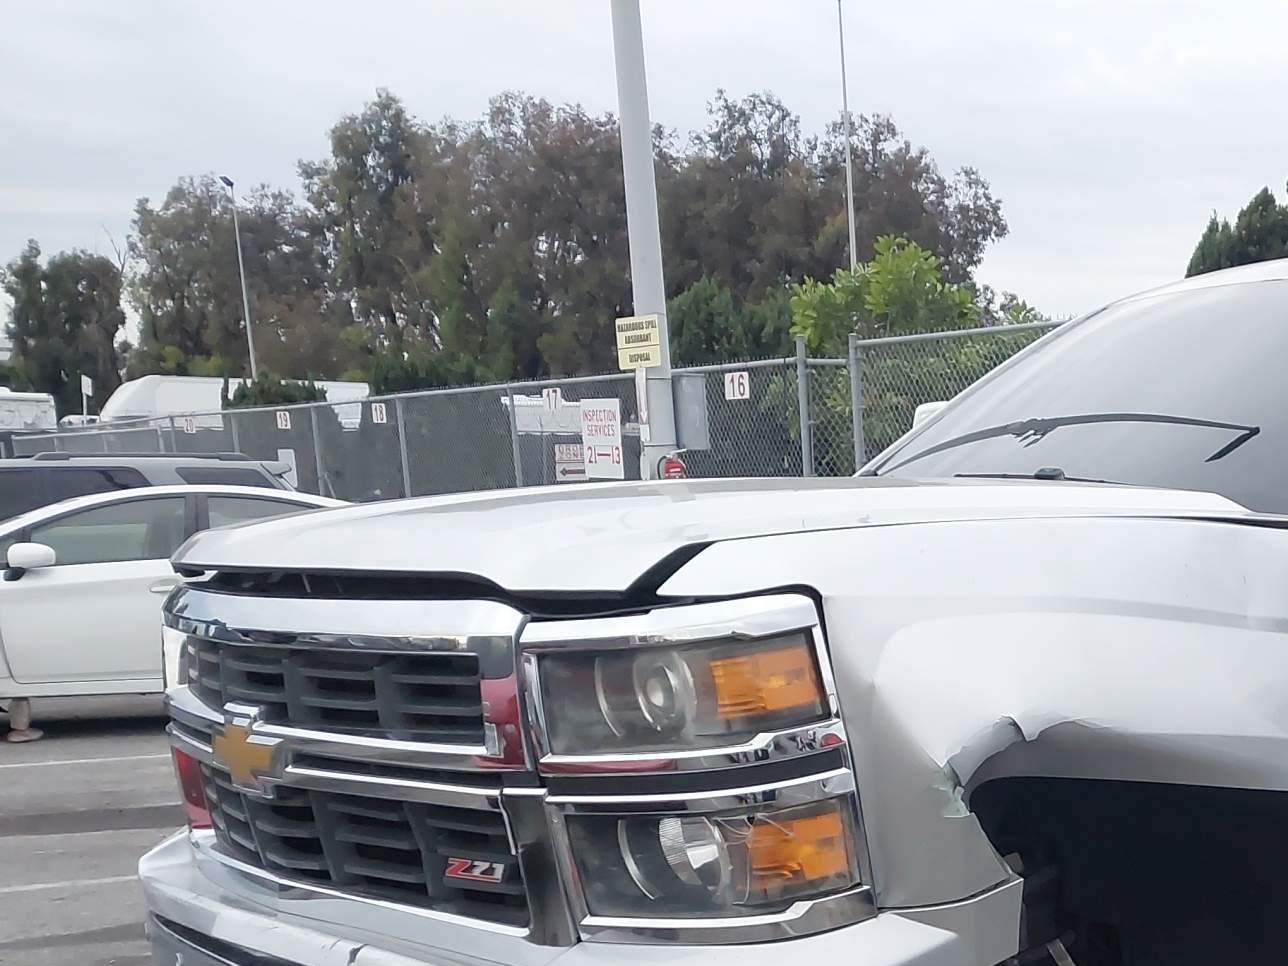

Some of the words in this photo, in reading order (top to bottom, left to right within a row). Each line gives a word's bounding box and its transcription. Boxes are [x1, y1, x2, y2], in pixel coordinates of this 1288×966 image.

[617, 321, 644, 333] HAZARDOUS
[644, 319, 657, 330] SPILL
[628, 351, 651, 363] DISPOSAL
[729, 374, 746, 398] 16
[546, 389, 558, 409] 17
[279, 412, 289, 428] 19
[374, 405, 385, 421] 18
[582, 408, 617, 422] INSPECTION
[184, 417, 195, 433] 20
[586, 424, 616, 437] SERVICES
[445, 857, 505, 884] Z71
